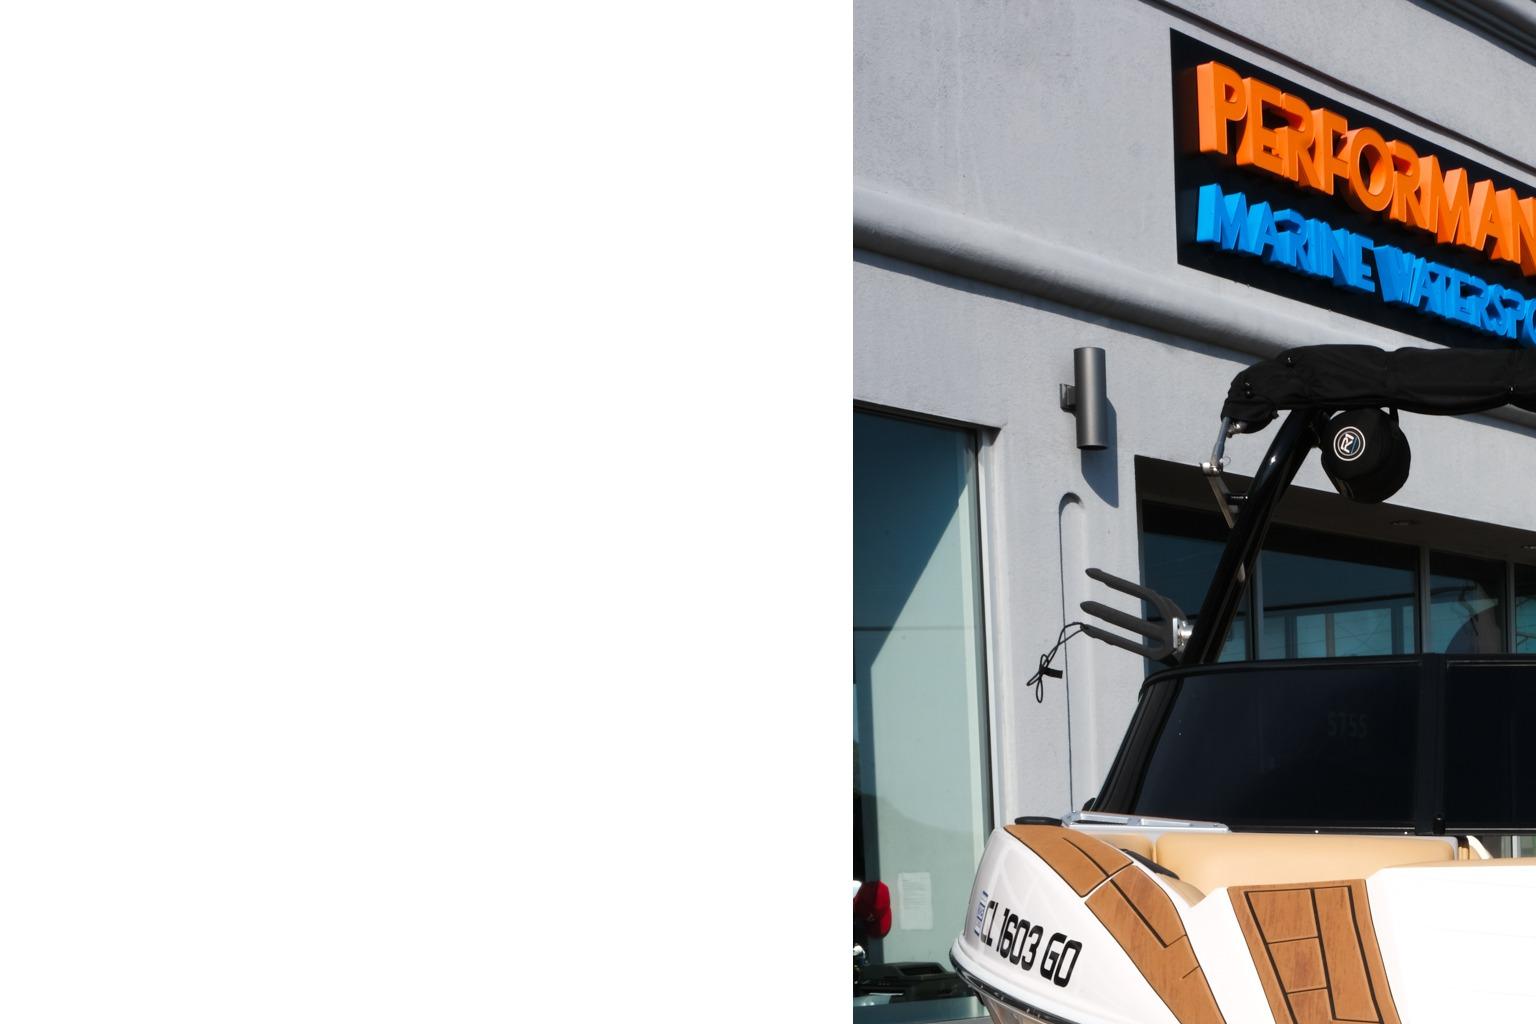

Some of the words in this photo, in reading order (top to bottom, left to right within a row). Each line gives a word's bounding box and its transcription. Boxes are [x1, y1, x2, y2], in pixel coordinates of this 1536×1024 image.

[1196, 183, 1376, 293] MARINE
[981, 900, 999, 947] CL
[996, 907, 1044, 971] 1603
[1040, 932, 1083, 988] GO
